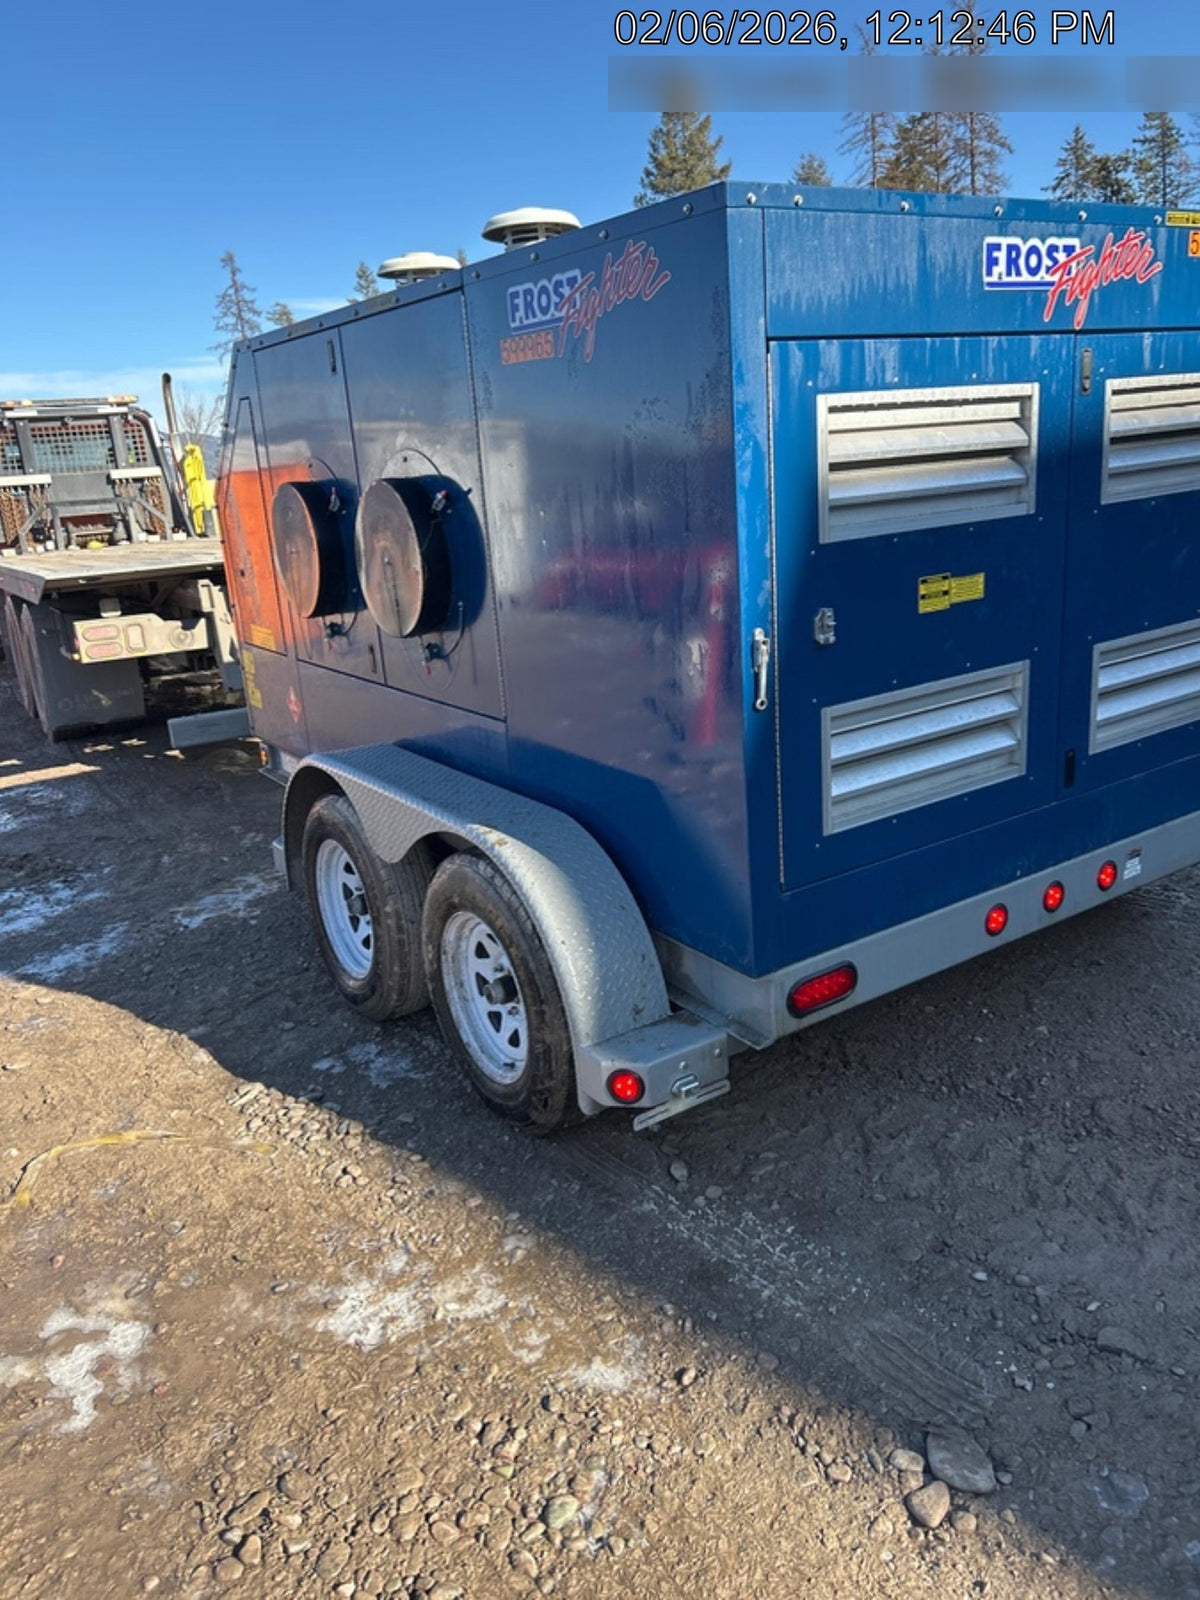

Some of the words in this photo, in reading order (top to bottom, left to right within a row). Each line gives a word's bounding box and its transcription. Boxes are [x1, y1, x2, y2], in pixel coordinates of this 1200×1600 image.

[508, 275, 579, 324] FROST
[558, 240, 671, 362] Fighter
[984, 242, 1078, 279] FROST
[1044, 227, 1163, 329] Fighter
